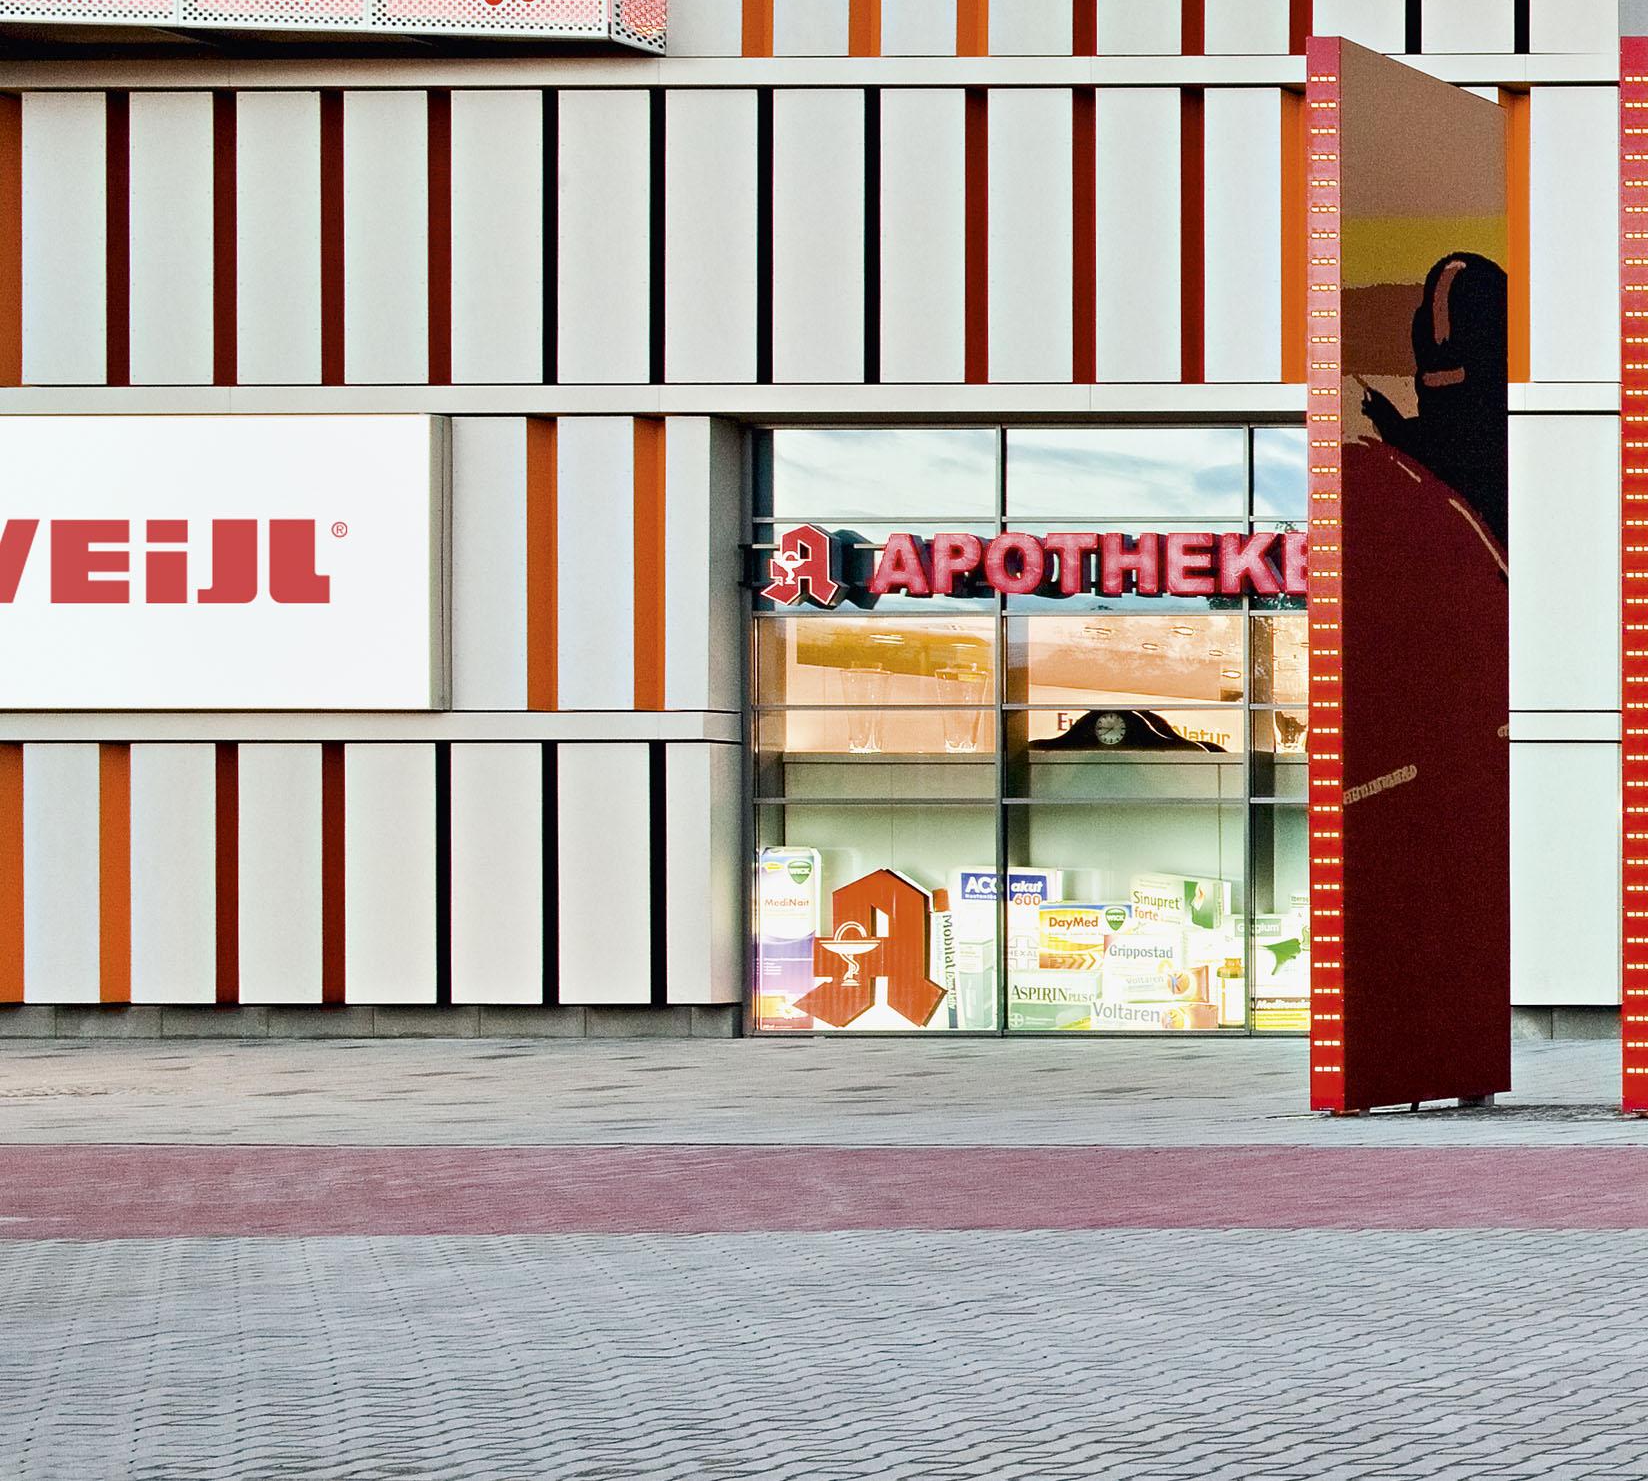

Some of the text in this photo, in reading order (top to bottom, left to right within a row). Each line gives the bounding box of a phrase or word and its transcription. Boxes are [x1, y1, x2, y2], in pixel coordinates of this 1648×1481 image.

[1010, 880, 1043, 893] akut
[1014, 894, 1041, 906] 600
[1133, 890, 1181, 911] Sinupret
[1134, 906, 1160, 922] forte
[1048, 916, 1099, 930] DayMed
[1109, 944, 1174, 960] Grippostad
[1011, 985, 1068, 1003] ASPIRIN
[1093, 1002, 1160, 1023] Voltaren
